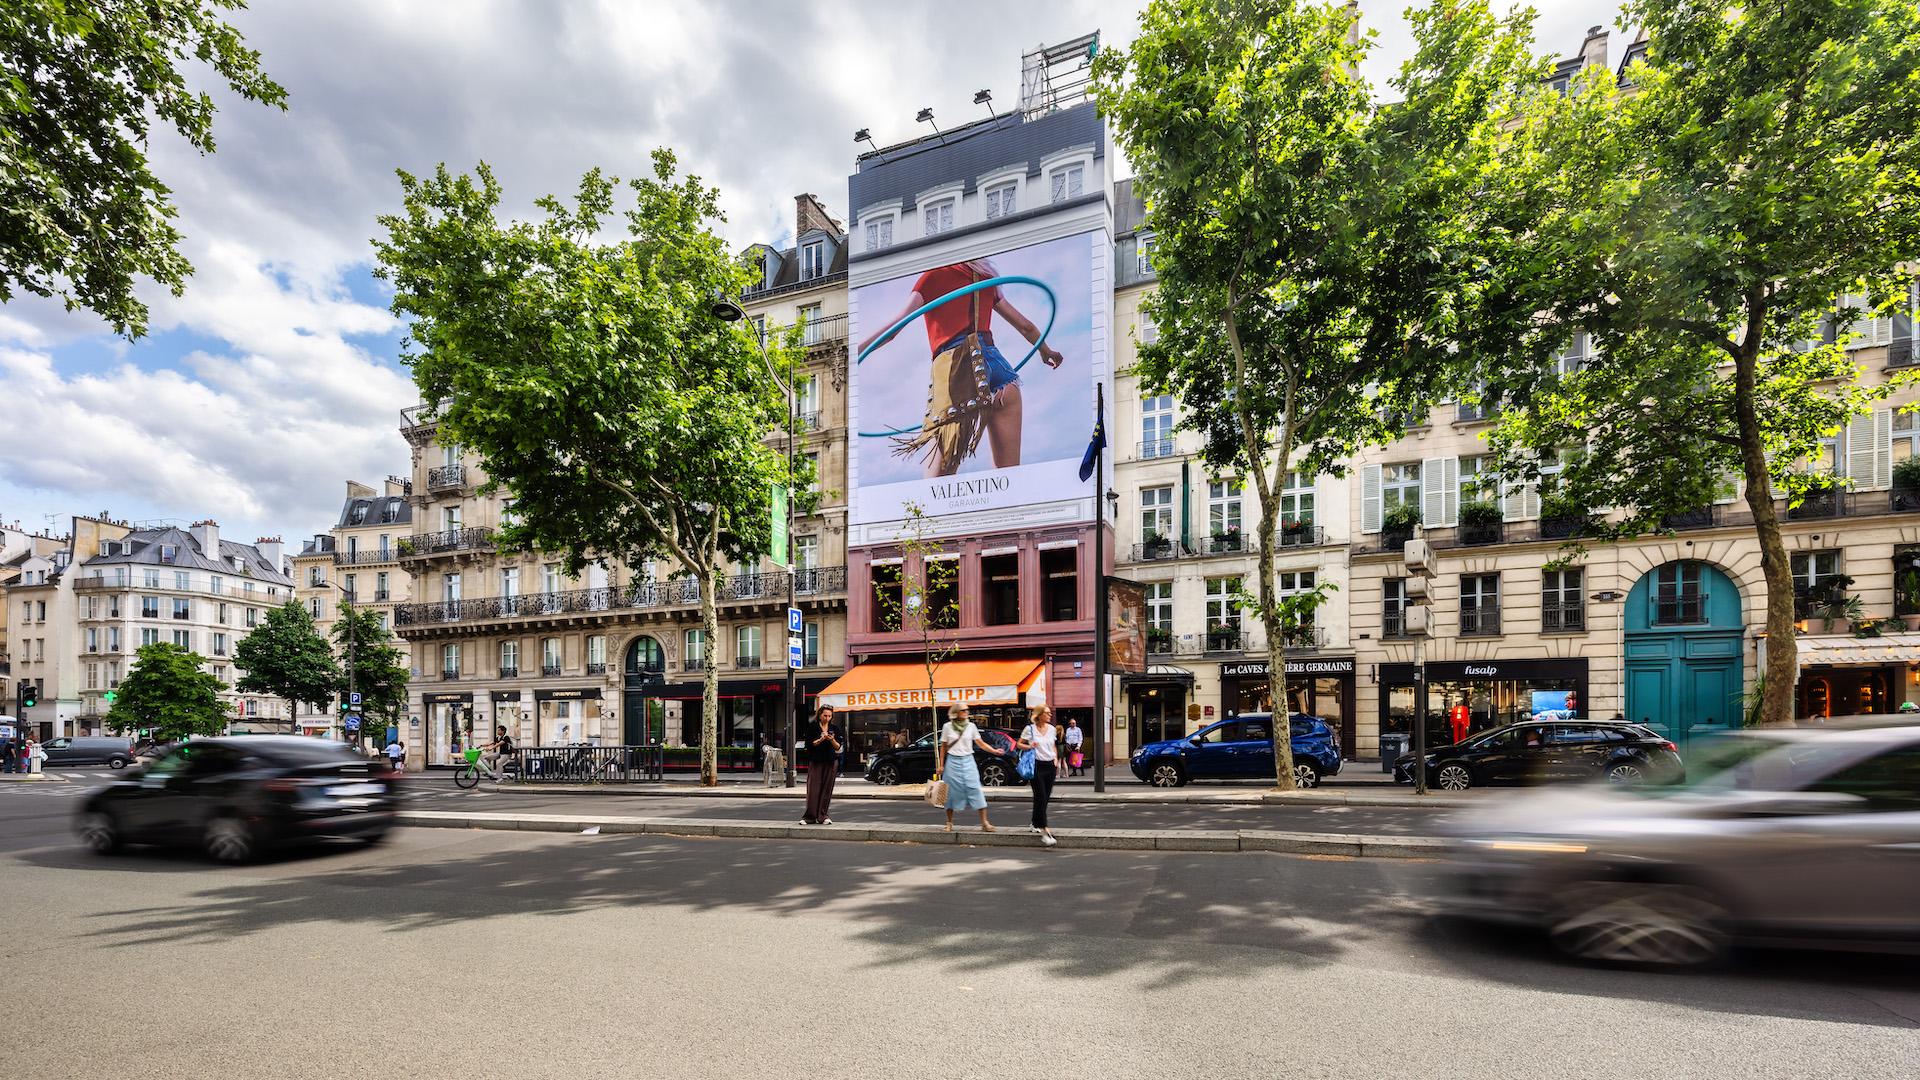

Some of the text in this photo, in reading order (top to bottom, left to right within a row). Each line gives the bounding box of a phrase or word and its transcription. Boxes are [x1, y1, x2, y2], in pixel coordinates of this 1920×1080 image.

[931, 476, 1009, 499] VALENTINO
[949, 497, 989, 509] GARAVANI
[792, 613, 799, 627] P
[1224, 665, 1237, 675] Les
[1237, 664, 1263, 674] CAVES
[1284, 661, 1305, 673] IÈRE
[1305, 661, 1353, 672] GERMAINE
[1464, 665, 1498, 677] fusalp
[846, 688, 986, 706] BRASSERIE LIPP
